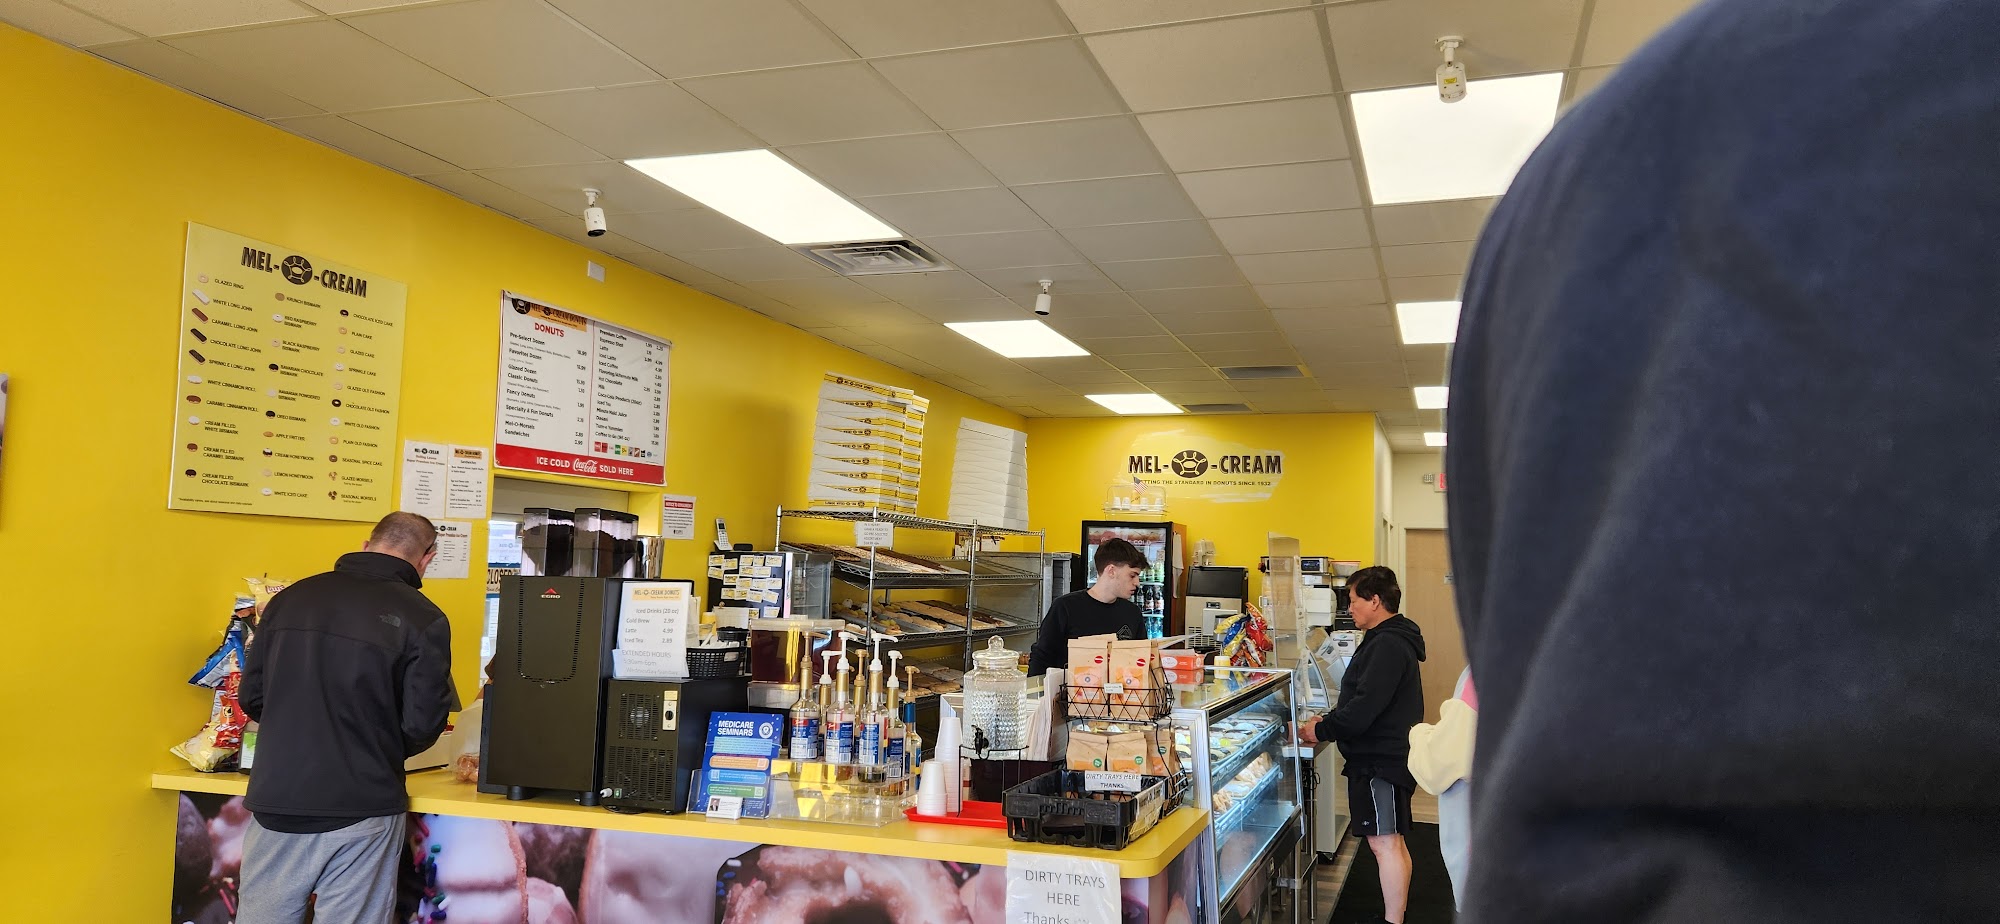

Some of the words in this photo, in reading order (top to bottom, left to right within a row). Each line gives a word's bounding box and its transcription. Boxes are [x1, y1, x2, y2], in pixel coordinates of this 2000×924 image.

[215, 279, 232, 287] GLAZED
[213, 298, 227, 306] WHITE
[212, 319, 233, 328] CARAMEL
[534, 323, 564, 337] DONUTS
[210, 339, 236, 349] CHOCOLATE
[506, 404, 526, 413] Specialty
[505, 429, 530, 437] Sandwiches
[537, 457, 548, 465] ICE
[550, 459, 570, 468] COLD
[600, 464, 616, 473] SOLD
[718, 720, 754, 729] MEDICARE
[717, 728, 753, 736] SEMINARS
[1025, 870, 1061, 884] DIRTY
[1066, 874, 1105, 889] TRAYS
[1047, 892, 1080, 906] HERE
[1024, 911, 1069, 924] Thanks
